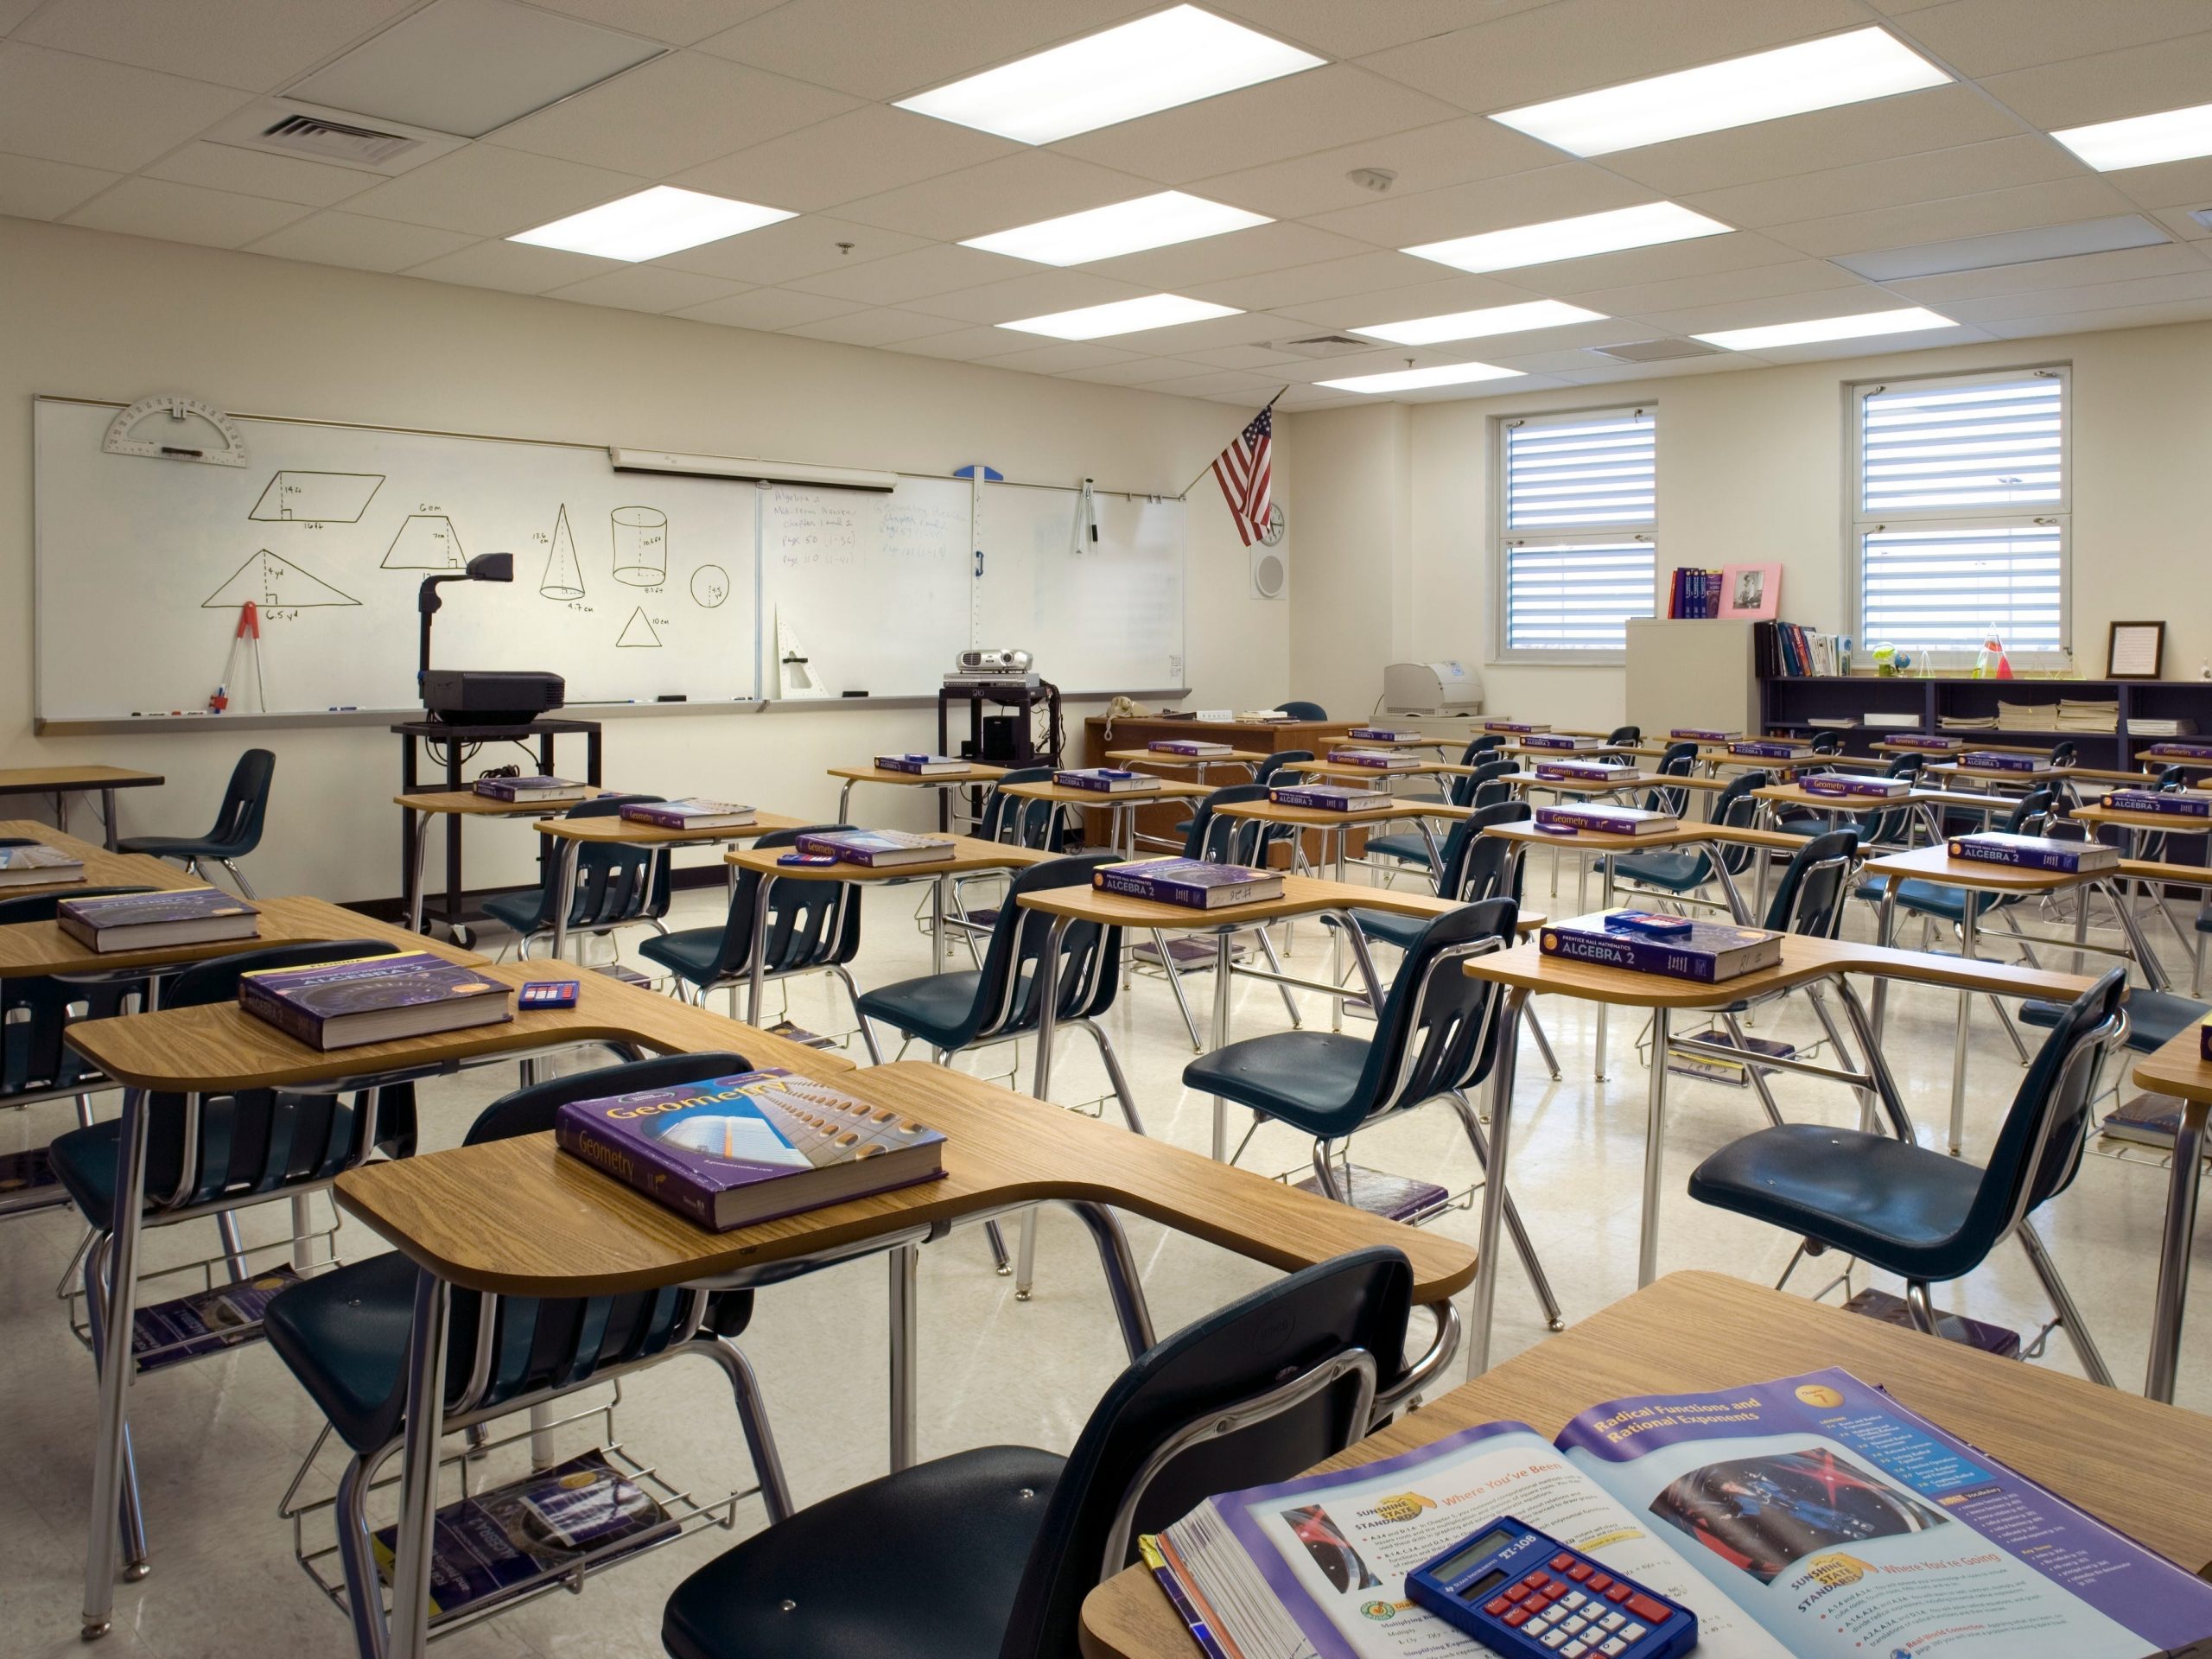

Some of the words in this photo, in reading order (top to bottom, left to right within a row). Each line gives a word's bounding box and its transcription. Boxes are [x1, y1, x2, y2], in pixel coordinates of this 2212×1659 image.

[775, 489, 809, 503] Algebra
[266, 610, 283, 620] 6.5
[287, 610, 298, 621] yd
[1735, 747, 1759, 755] ALGEBRA
[2164, 747, 2191, 756] Geometry
[1337, 756, 1359, 765] Geometry
[1548, 767, 1574, 777] Geometry
[1059, 778, 1080, 786] ALGEBRA
[1815, 779, 1847, 790] Geometry
[1279, 796, 1307, 805] ALGEBRA
[2114, 800, 2152, 810] ALGEBRA
[630, 810, 653, 823] Geometry
[1553, 815, 1588, 827] Geometry
[808, 842, 836, 855] Geometry
[1965, 849, 2010, 861] ALGEBRA
[2013, 854, 2018, 862] 2
[1107, 880, 1146, 895] ALGEBRA
[1562, 935, 1585, 944] PRENTICE
[1598, 940, 1631, 951] MATHEMATICS
[1562, 943, 1623, 963] ALGEBRA
[1627, 954, 1635, 964] 2
[304, 969, 406, 985] ALGEBRA
[249, 994, 276, 1020] ALGEBRA
[607, 1077, 789, 1120] Geometry
[578, 1129, 634, 1181] Geometry
[1593, 1406, 1655, 1433] Radical
[1656, 1403, 1730, 1418] Functions
[1731, 1397, 1762, 1411] and
[1607, 1415, 1679, 1444] Rational
[1679, 1411, 1760, 1426] Exponents
[1442, 1487, 1485, 1507] Where
[1485, 1471, 1529, 1491] You've
[1529, 1460, 1563, 1477] Been
[1963, 1487, 2002, 1498] Vocabulary
[1356, 1500, 1409, 1517] SUNSHINE
[1382, 1505, 1414, 1521] STATE
[1427, 1516, 1450, 1528] Chapter
[1470, 1498, 1496, 1512] reviewed
[1497, 1482, 1538, 1502] computational
[1355, 1511, 1417, 1530] STANDARDS
[1436, 1513, 1478, 1529] multiplication
[1551, 1510, 1583, 1527] polynomial
[475, 1521, 519, 1559] ALGEBRA
[1497, 1535, 1536, 1560] TI-108
[1879, 1560, 1923, 1574] Where
[1923, 1558, 1960, 1572] You're
[1960, 1552, 2002, 1569] Going
[1452, 1578, 1466, 1590] TEXAS
[1466, 1559, 1498, 1580] INSTRUMENTS
[1791, 1560, 1845, 1591] SUNSHINE
[1819, 1567, 1853, 1585] STATE
[1798, 1573, 1863, 1613] STANDARDS
[1844, 1594, 1856, 1604] and
[1834, 1606, 1849, 1620] cube
[1381, 1616, 1422, 1629] Multiplying
[1852, 1618, 1871, 1633] divide
[1388, 1628, 1416, 1637] Multiply
[1870, 1623, 1906, 1648] translations
[1905, 1629, 1946, 1649] Real-World
[1403, 1644, 1446, 1658] Simplifying
[1915, 1643, 1932, 1656] page
